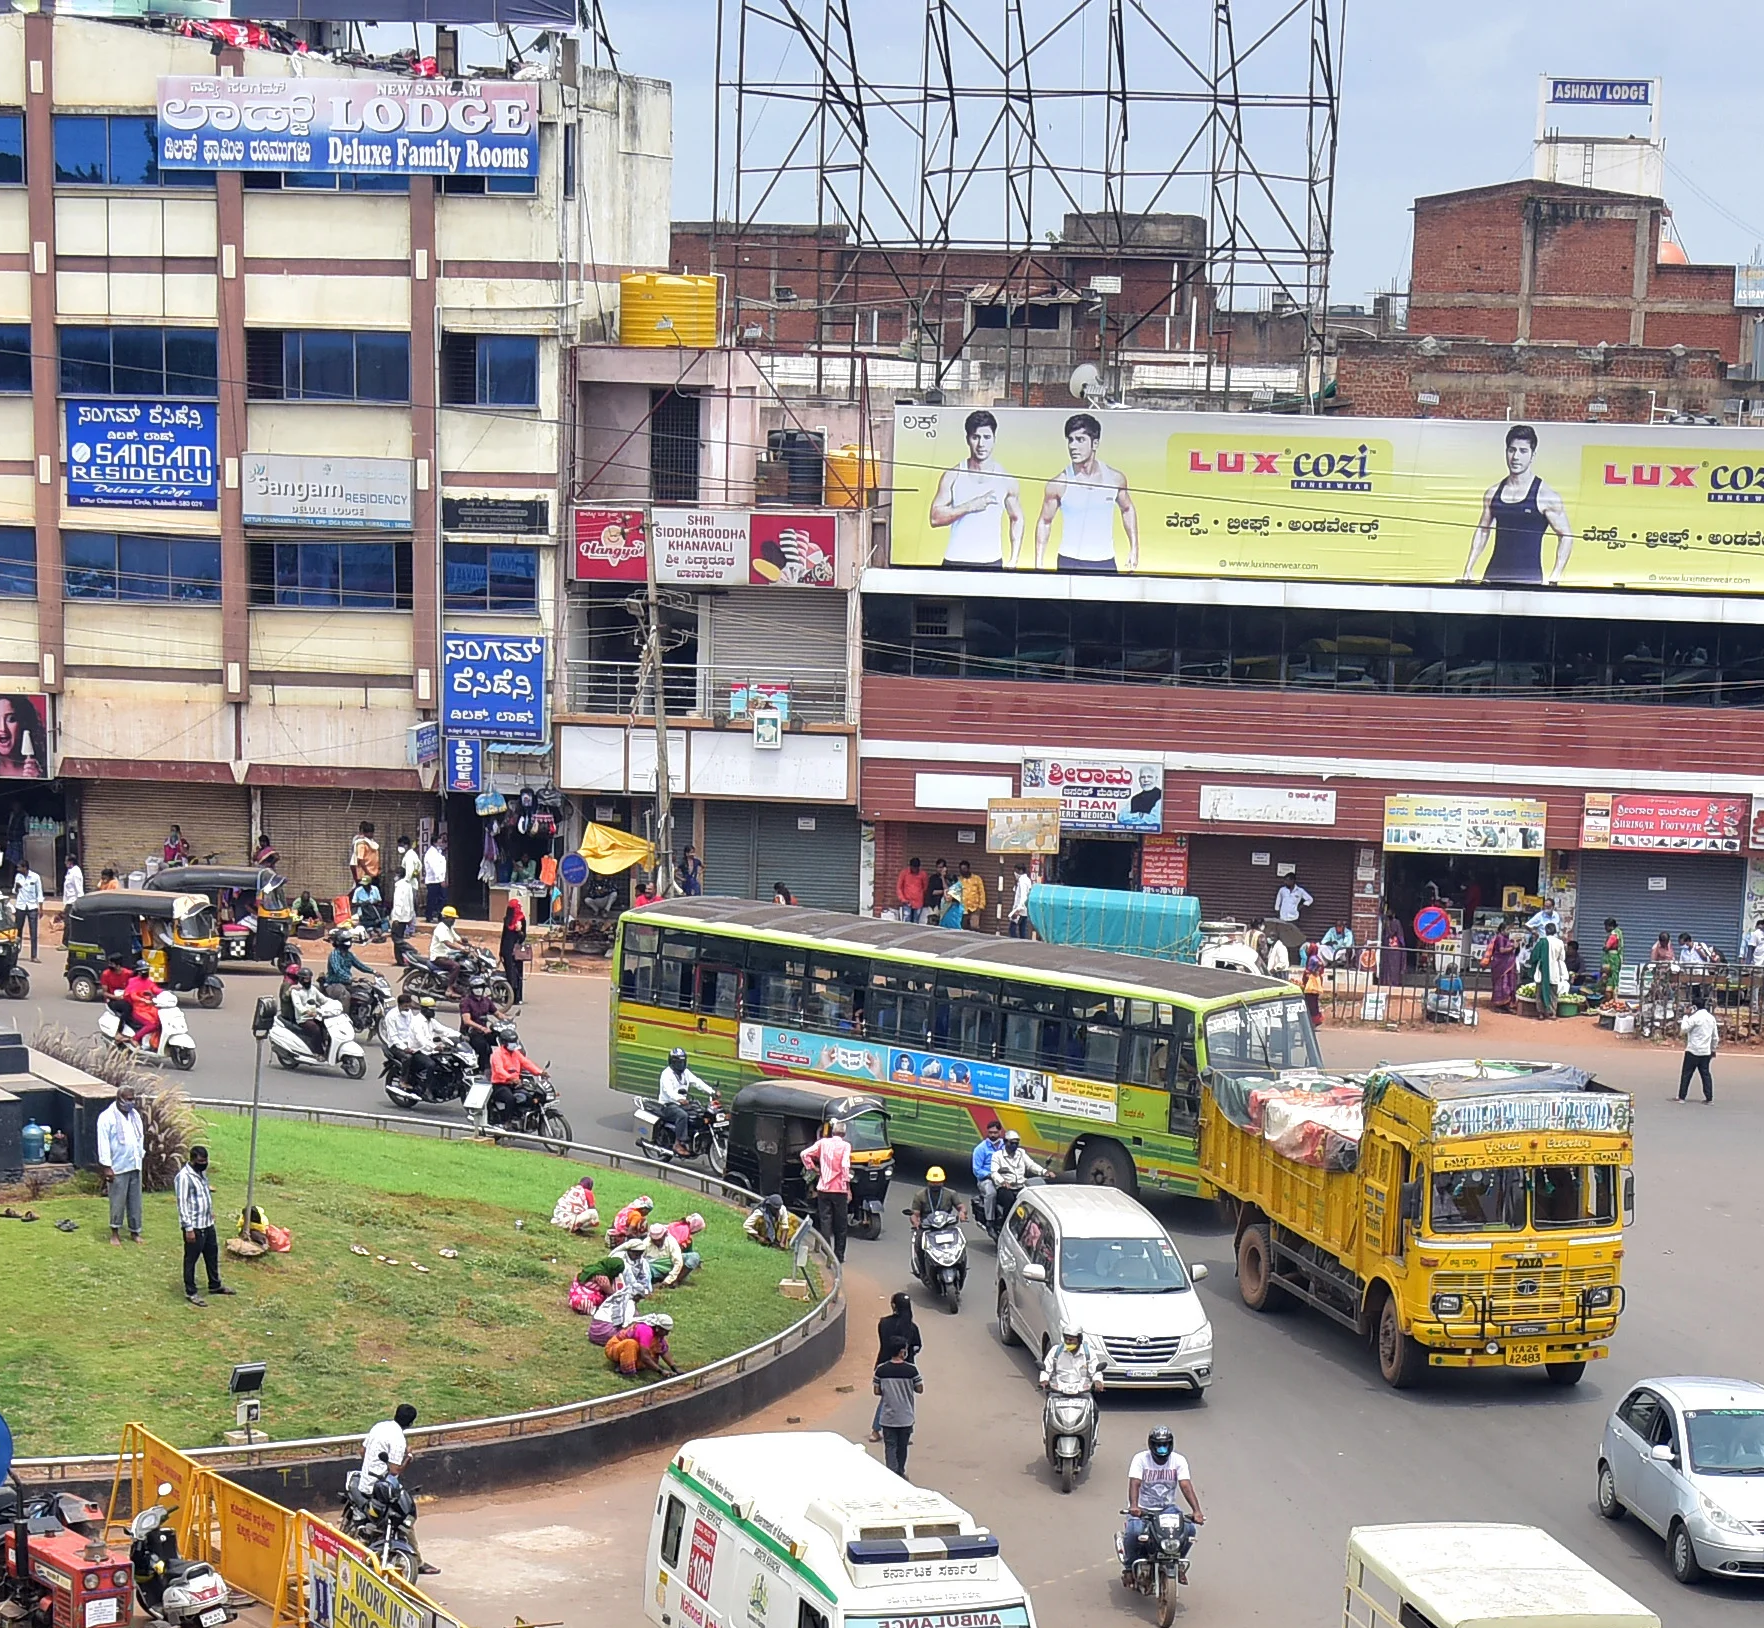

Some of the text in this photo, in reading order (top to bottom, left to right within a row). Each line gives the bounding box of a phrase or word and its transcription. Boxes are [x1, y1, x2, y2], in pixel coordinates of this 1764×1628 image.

[1555, 84, 1645, 101] ASHRAY LODGE
[329, 96, 531, 135] LODGE
[328, 137, 529, 172] Deluxe Family Rooms
[78, 404, 141, 425] ಸಂಗಮ್
[96, 444, 212, 467] SANGAM
[1188, 444, 1371, 479] LUX cozi
[72, 465, 212, 486] RESIDENCY
[1603, 463, 1699, 488] LUX
[256, 476, 407, 506] Sangam RESIDENCY
[291, 505, 364, 516] DELUXE LODGE
[687, 514, 715, 528] SHRI
[655, 526, 747, 541] SIDDHAROODHA
[668, 539, 734, 553] KHANAVALI
[1228, 559, 1319, 571] www.luxinnerwear.com
[1658, 574, 1751, 585] www.luxinnerwear.com
[445, 638, 541, 664] ಸಂಗಮ್
[453, 666, 535, 703] ರೆಸಿಡೆನ್ಸಿ
[455, 740, 474, 780] LODGE
[1048, 762, 1133, 786] ಶ್ರೀರಾಮ
[1080, 811, 1115, 820] MEDICAL
[1612, 818, 1703, 833] SHRINGAR FOOTWEAR
[1485, 1139, 1523, 1154] Goods
[1515, 1257, 1544, 1268] TATA
[1509, 1353, 1541, 1365] A2483
[1511, 1344, 1539, 1354] KA 26
[693, 1551, 711, 1597] 108
[882, 1560, 978, 1581] ಕರ್ನಾಟಕ ಸರ್ಕಾರ
[355, 1570, 388, 1619] WORK
[680, 1592, 704, 1627] National
